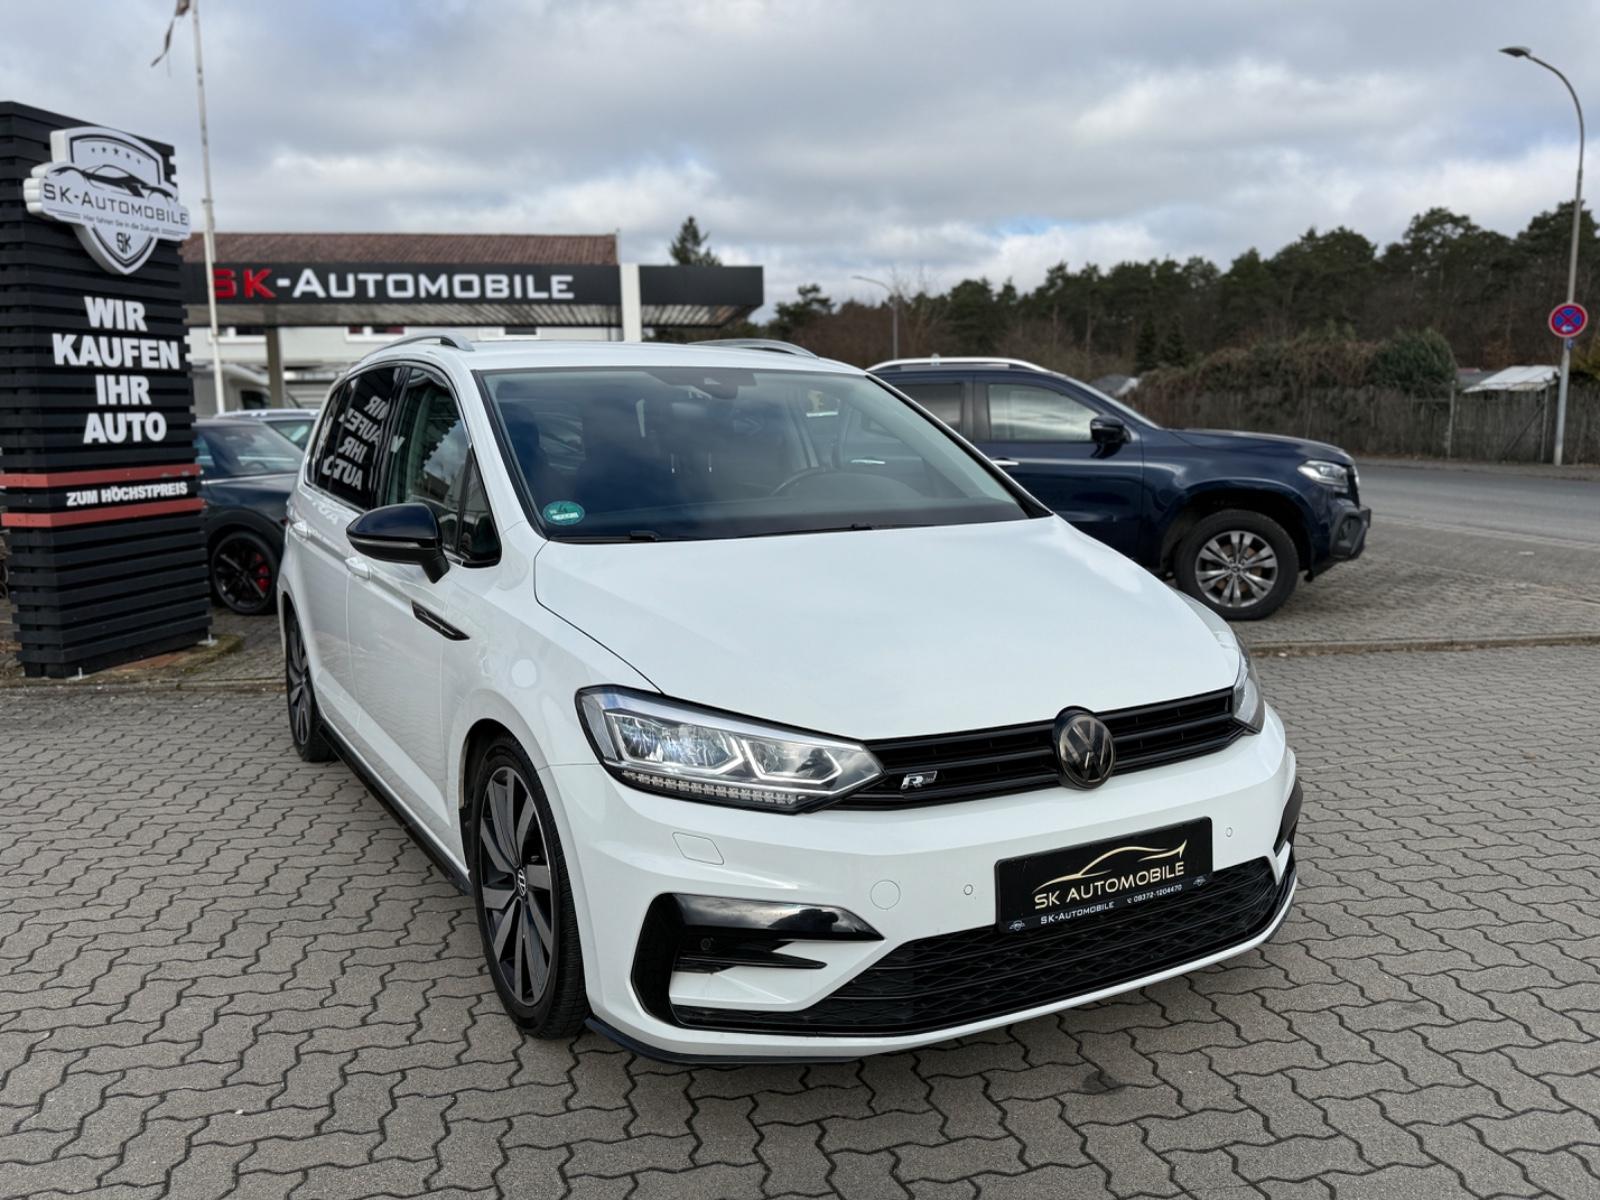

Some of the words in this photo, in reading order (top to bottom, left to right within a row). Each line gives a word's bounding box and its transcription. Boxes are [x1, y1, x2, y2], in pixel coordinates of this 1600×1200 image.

[43, 182, 189, 226] SK-AUTOMOBILE
[213, 267, 575, 299] SK-AUTOMOBILE
[84, 296, 148, 331] WIR
[52, 333, 180, 369] KAUFEN
[95, 375, 151, 405] IHR
[83, 412, 167, 443] AUTO
[66, 490, 99, 506] ZUM
[101, 482, 188, 503] HÖCHSTPREIS
[1034, 892, 1061, 910] SK
[1066, 861, 1185, 903] AUTOMOBILE
[1040, 901, 1115, 925] SK-AUTOMOBILE
